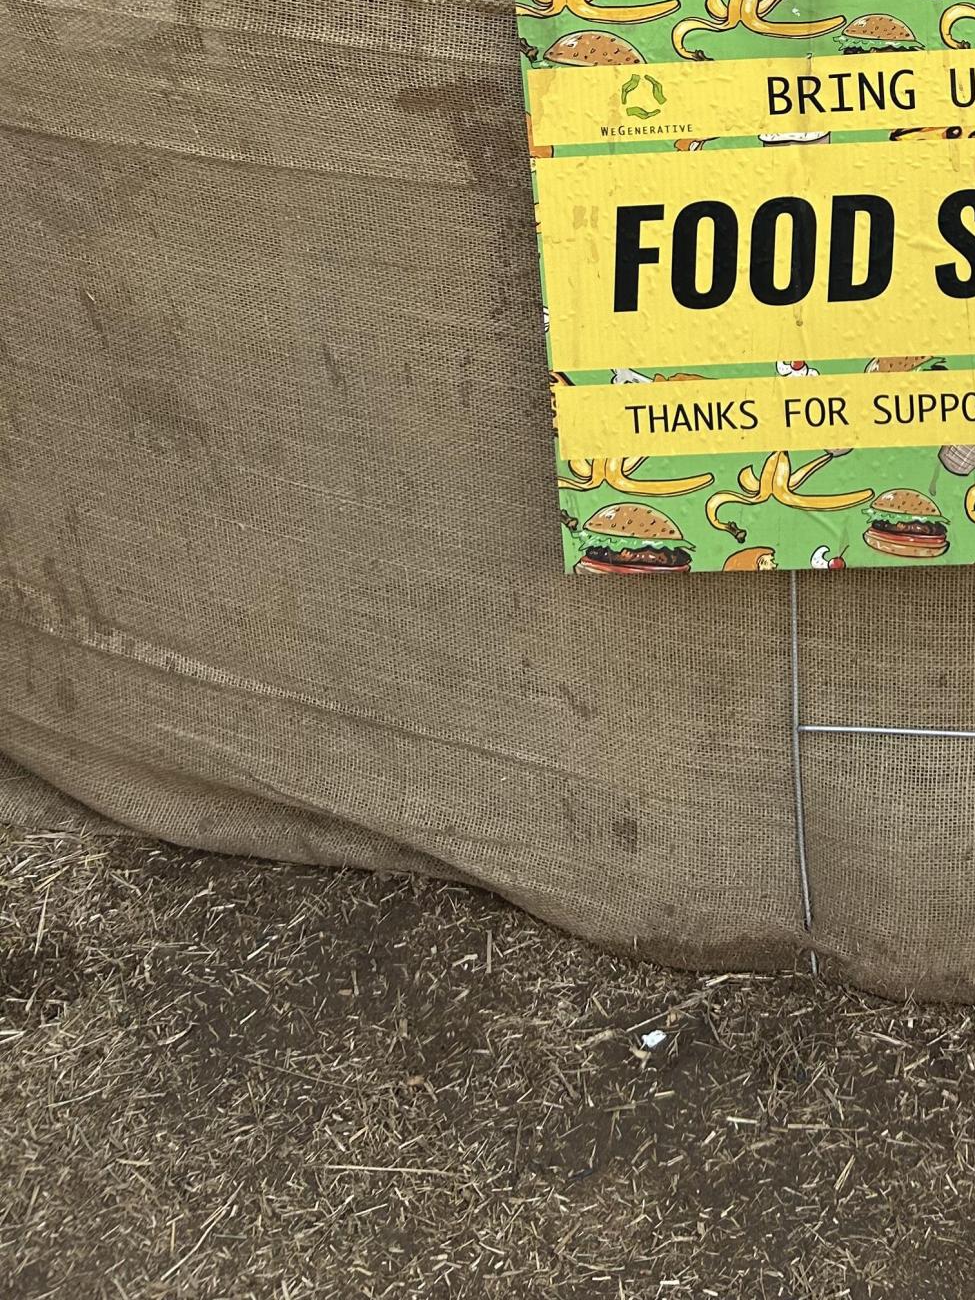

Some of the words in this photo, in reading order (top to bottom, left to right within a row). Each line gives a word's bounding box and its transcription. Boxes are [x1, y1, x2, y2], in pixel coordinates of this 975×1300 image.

[768, 70, 915, 115] BRING
[614, 195, 894, 312] FOOD
[625, 401, 757, 433] THANKS
[785, 398, 848, 427] FOR
